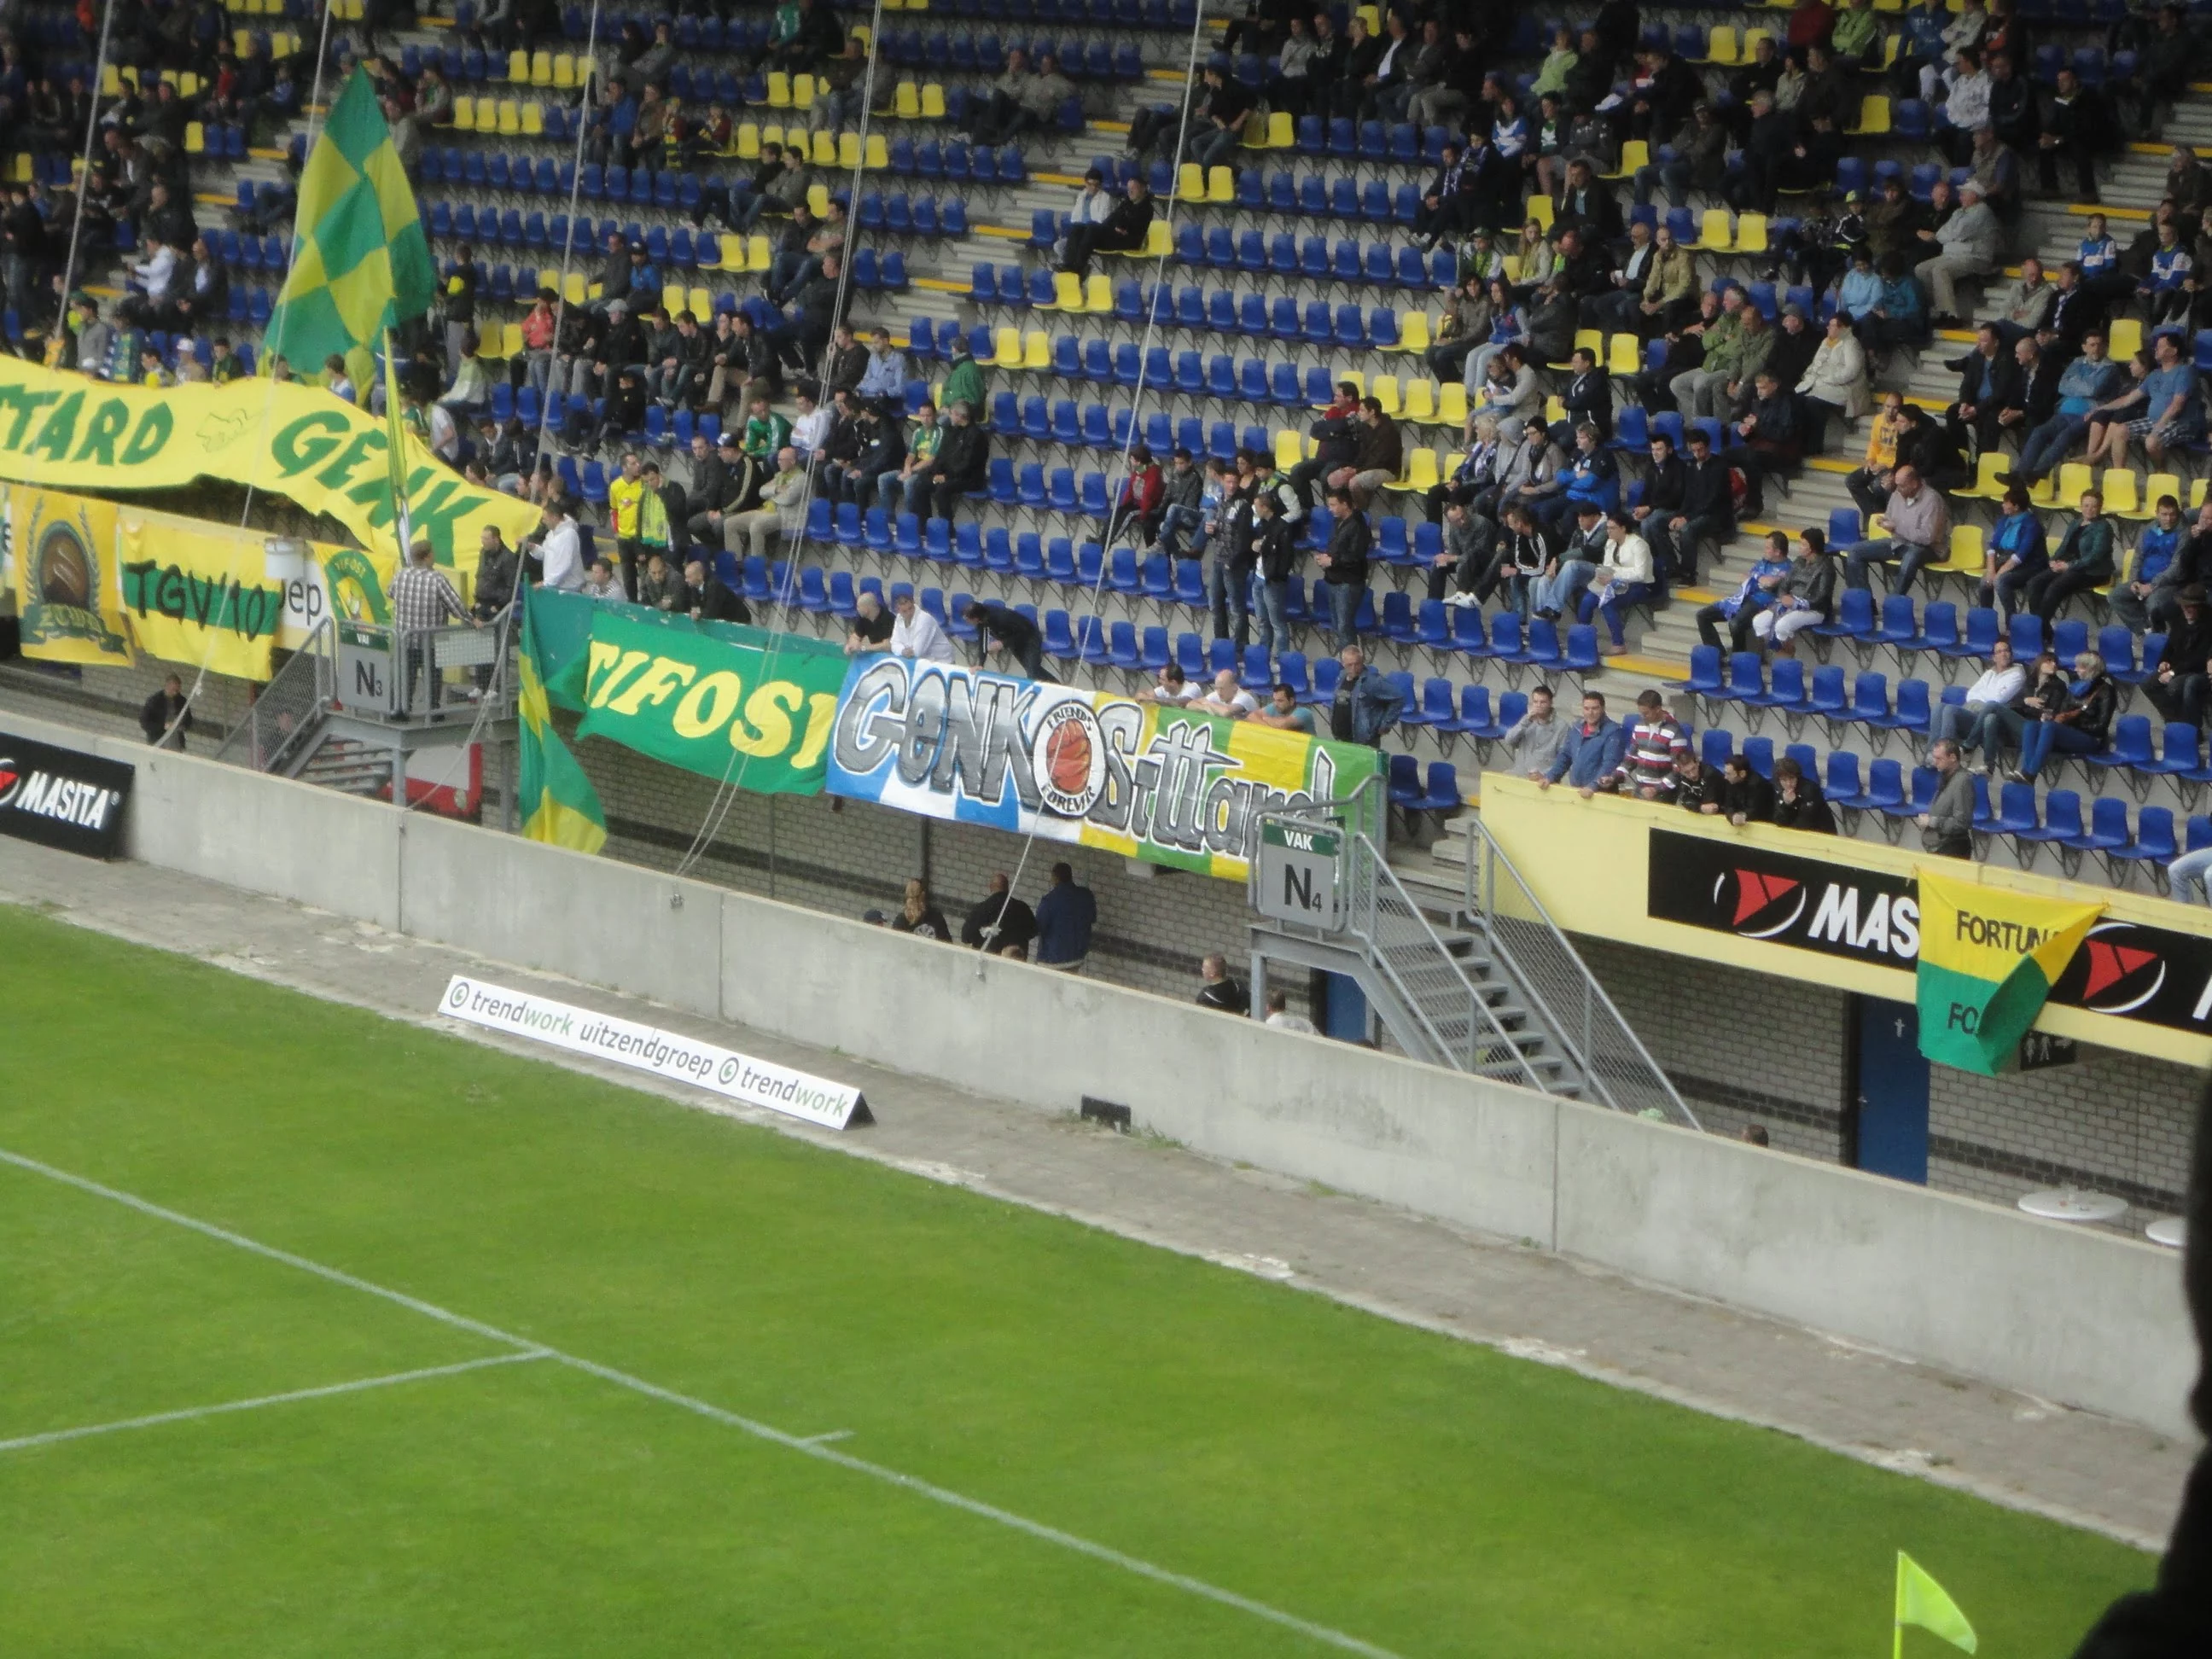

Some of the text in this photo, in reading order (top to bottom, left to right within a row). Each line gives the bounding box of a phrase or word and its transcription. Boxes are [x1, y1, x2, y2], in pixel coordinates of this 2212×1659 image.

[271, 410, 492, 568] GENK
[1284, 830, 1313, 852] VAK
[1807, 882, 1919, 959] MAS
[471, 990, 849, 1118] trendwork uitzendgroep trendwork
